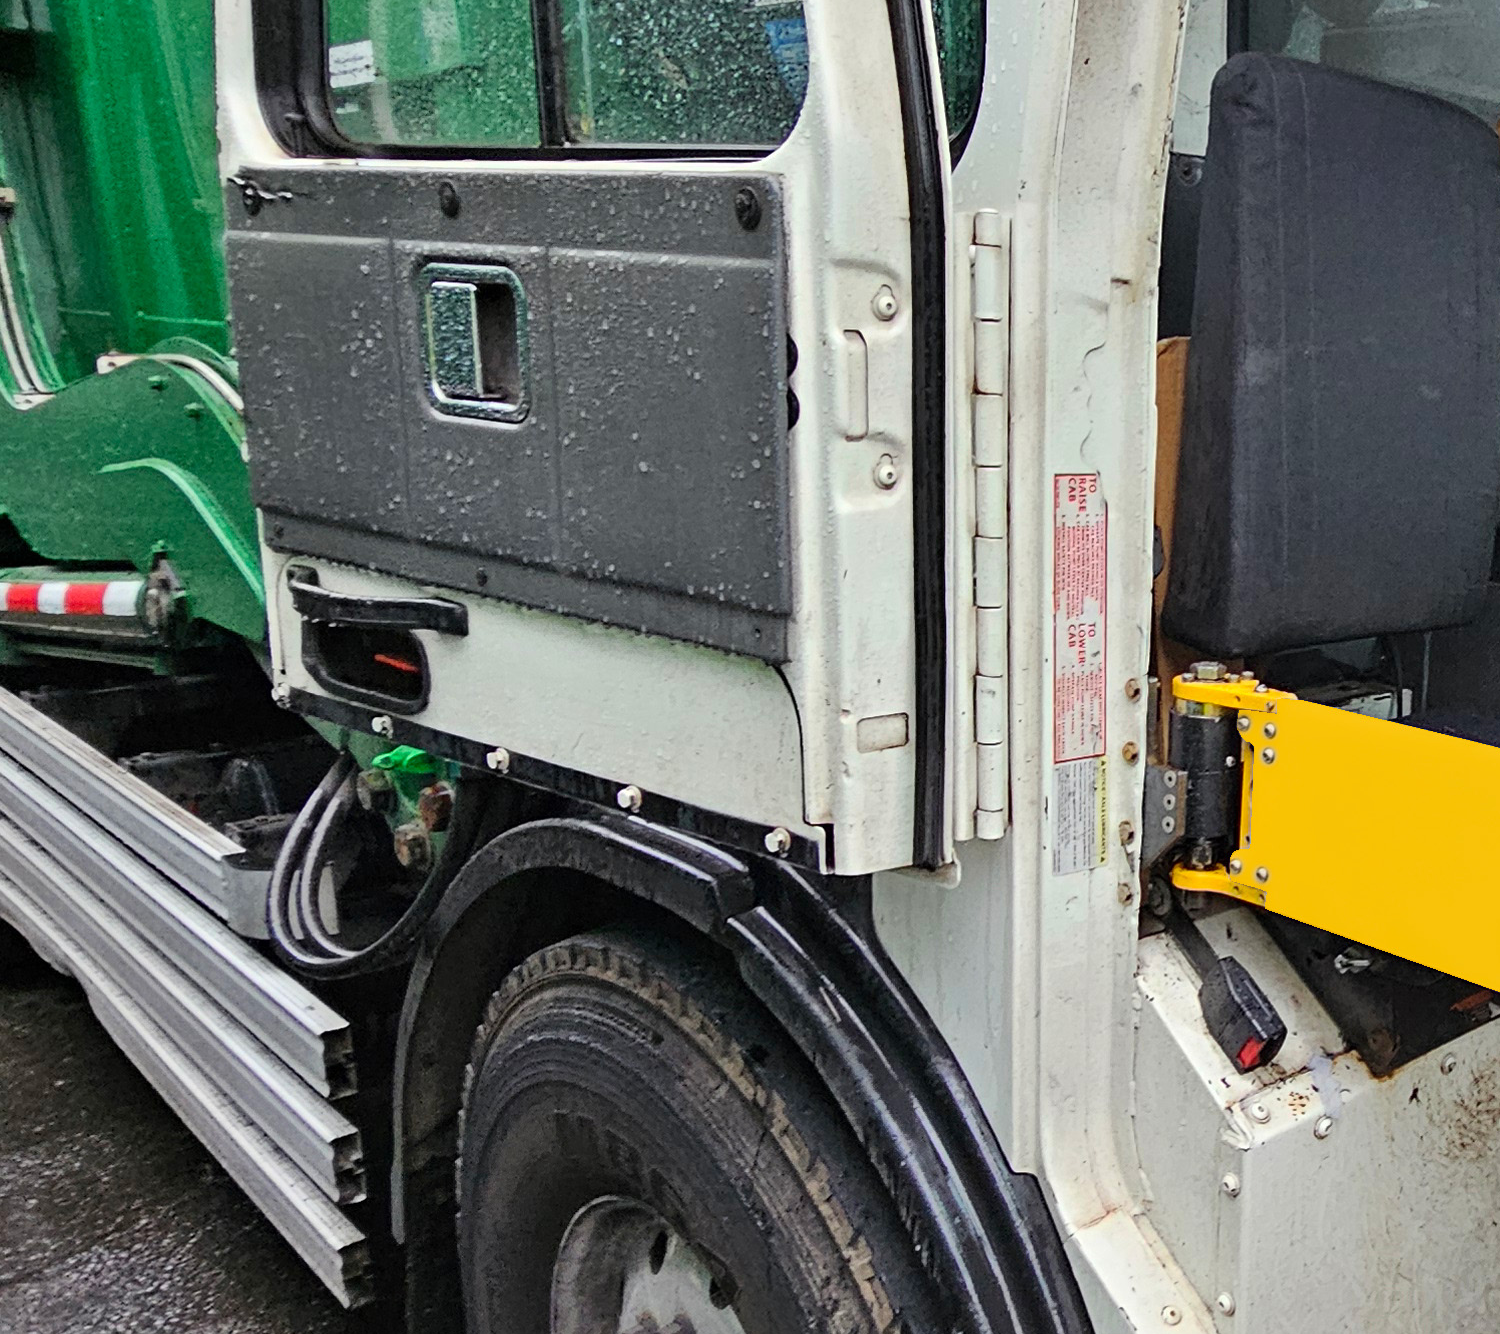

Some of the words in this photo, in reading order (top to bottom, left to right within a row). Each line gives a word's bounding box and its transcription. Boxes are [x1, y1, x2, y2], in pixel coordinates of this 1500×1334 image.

[1067, 477, 1077, 503] CAB
[1077, 477, 1087, 513] RAISE
[1087, 477, 1097, 493] TO
[1066, 624, 1076, 649] CAB
[1087, 622, 1096, 638] TO
[1077, 623, 1087, 664] LOWER
